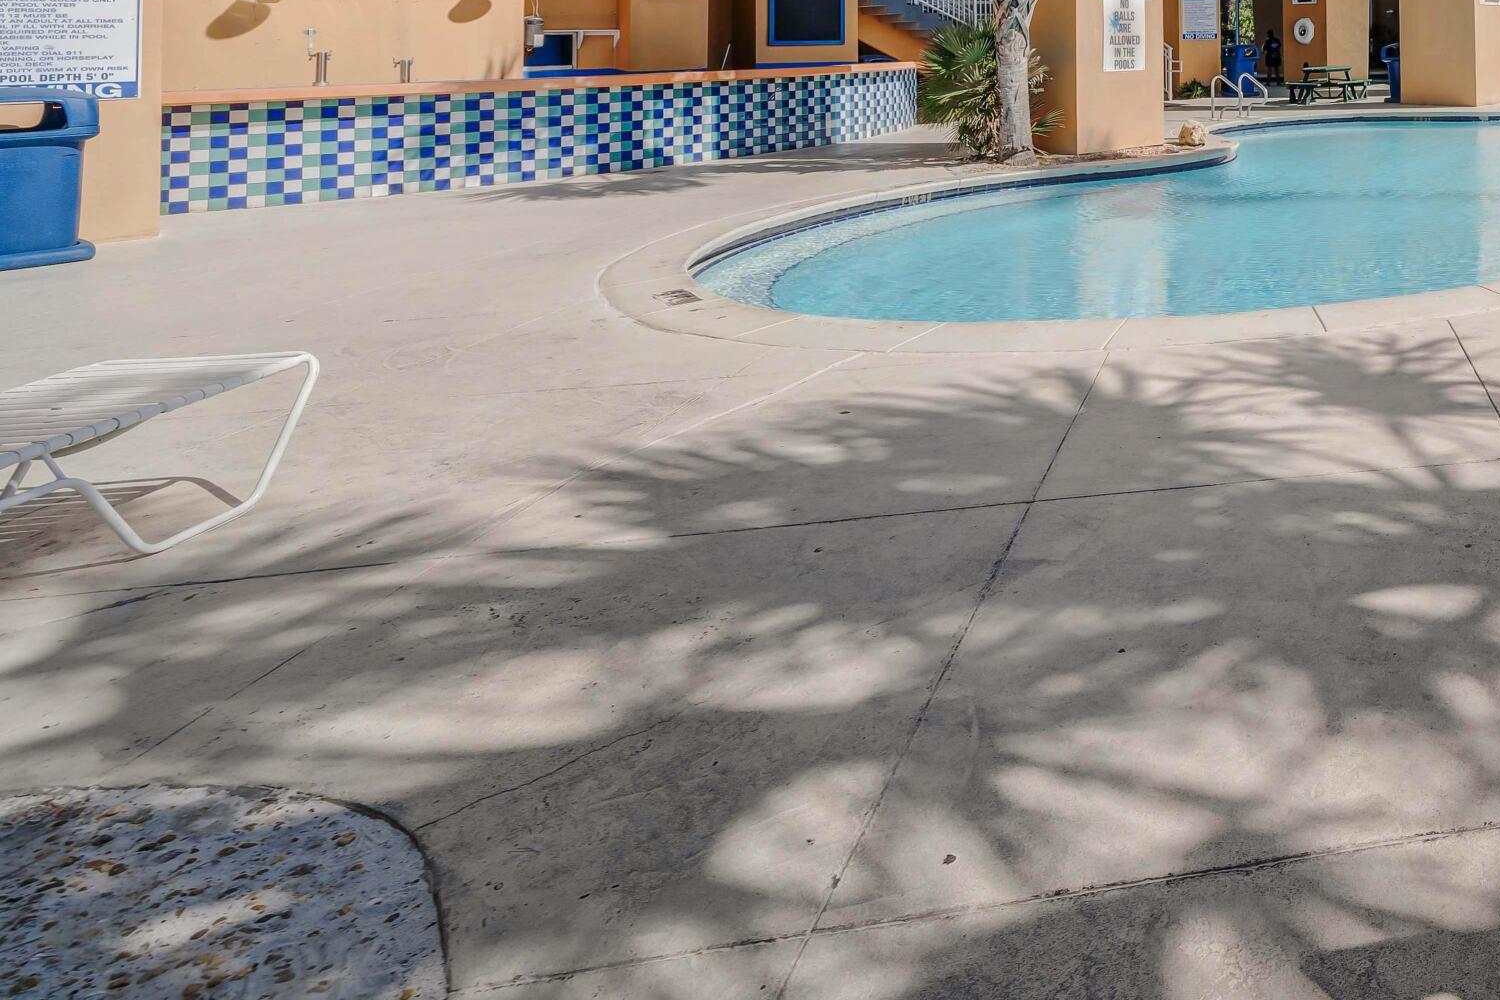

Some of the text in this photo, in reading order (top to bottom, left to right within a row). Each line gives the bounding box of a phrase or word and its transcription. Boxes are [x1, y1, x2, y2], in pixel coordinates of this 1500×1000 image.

[1120, 0, 1129, 9] NO
[1114, 11, 1135, 21] BALLS
[1118, 23, 1131, 33] ARE
[1109, 35, 1141, 46] ALLOWED
[1114, 47, 1135, 57] IN THE
[1114, 60, 1135, 70] POOLS
[0, 72, 115, 83] POOL DEPTH 5' 0"
